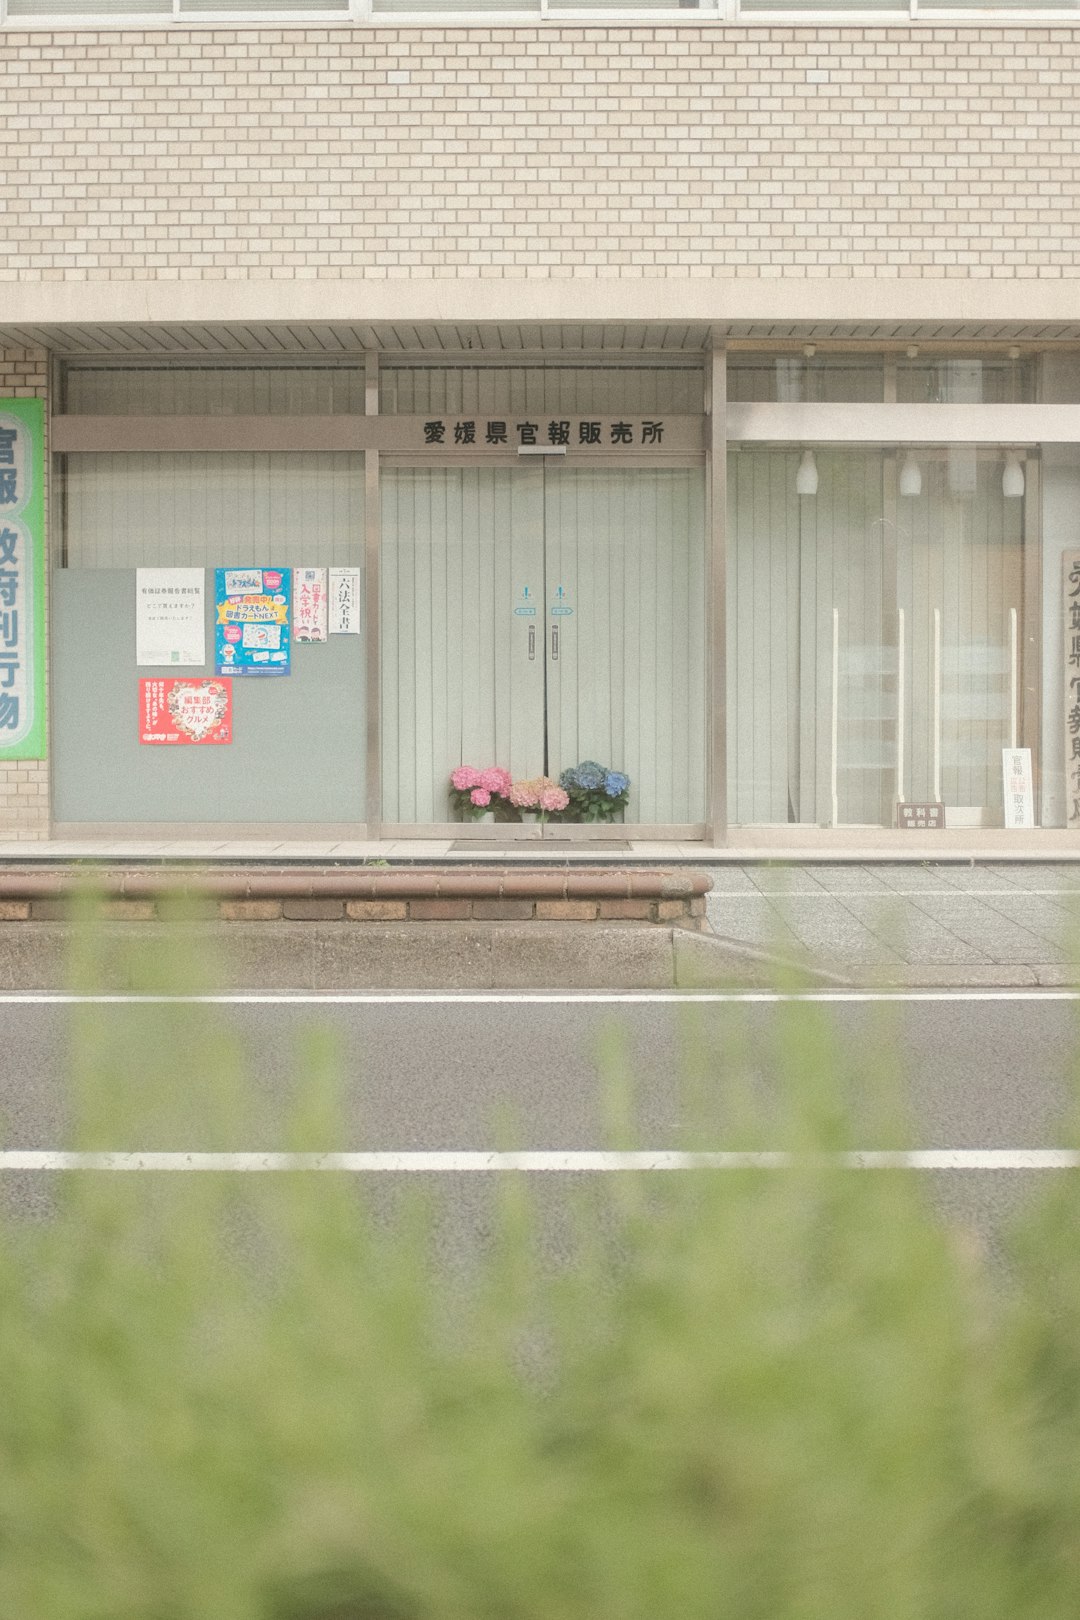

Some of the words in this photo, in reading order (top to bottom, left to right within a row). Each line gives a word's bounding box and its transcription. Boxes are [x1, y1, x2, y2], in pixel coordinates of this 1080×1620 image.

[423, 420, 664, 445] 愛媛県官報販売所
[236, 604, 269, 612] ドラえもん
[299, 583, 312, 624] 入学祝い
[338, 577, 350, 629] 六法全書
[181, 706, 214, 714] おすすめ
